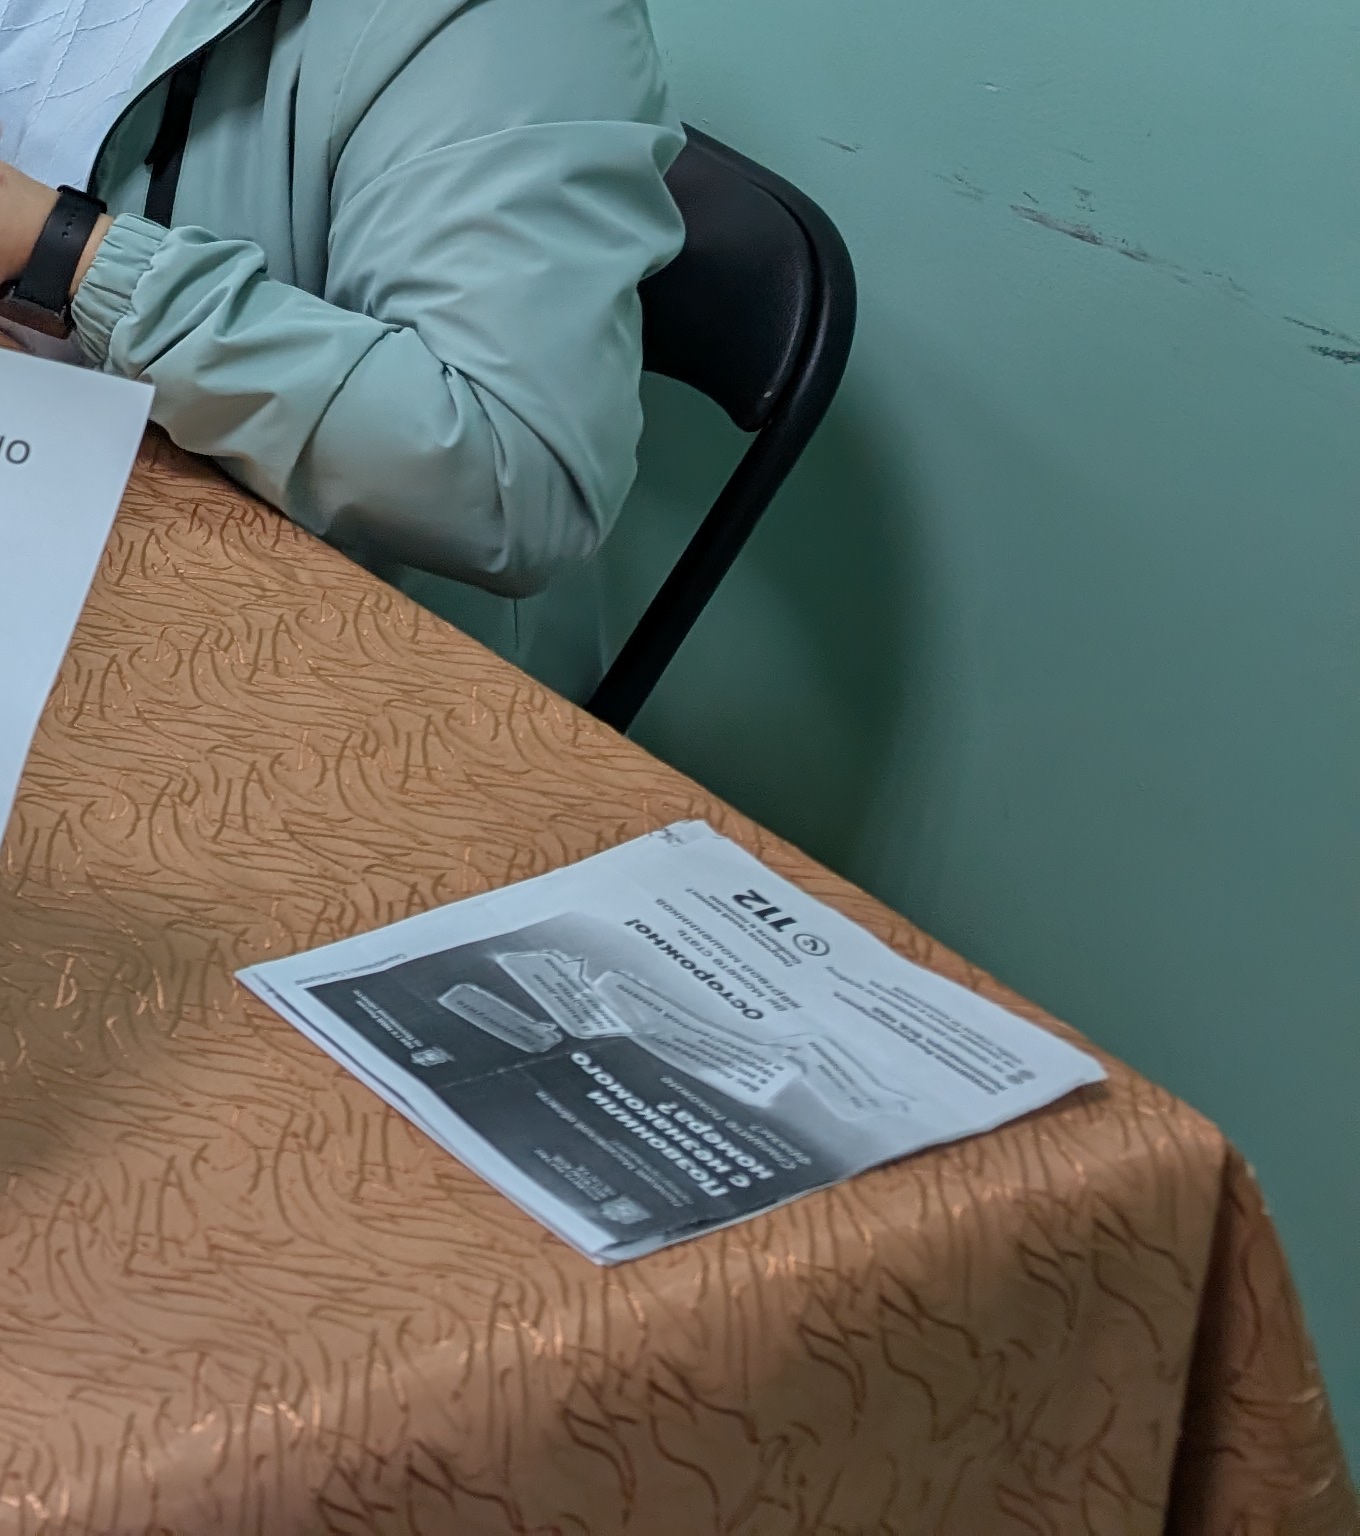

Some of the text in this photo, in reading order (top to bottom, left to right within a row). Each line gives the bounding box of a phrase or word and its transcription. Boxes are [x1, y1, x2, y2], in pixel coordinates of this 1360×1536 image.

[651, 898, 803, 1009] жертвой мошенников
[726, 888, 803, 933] 112
[621, 917, 768, 1021] Осторожно!
[672, 929, 788, 1012] Вы можете стать
[564, 1050, 734, 1174] незнакомого
[582, 1088, 730, 1197] Позвонили
[652, 1098, 778, 1180] номера?
[725, 1172, 757, 1189] с
